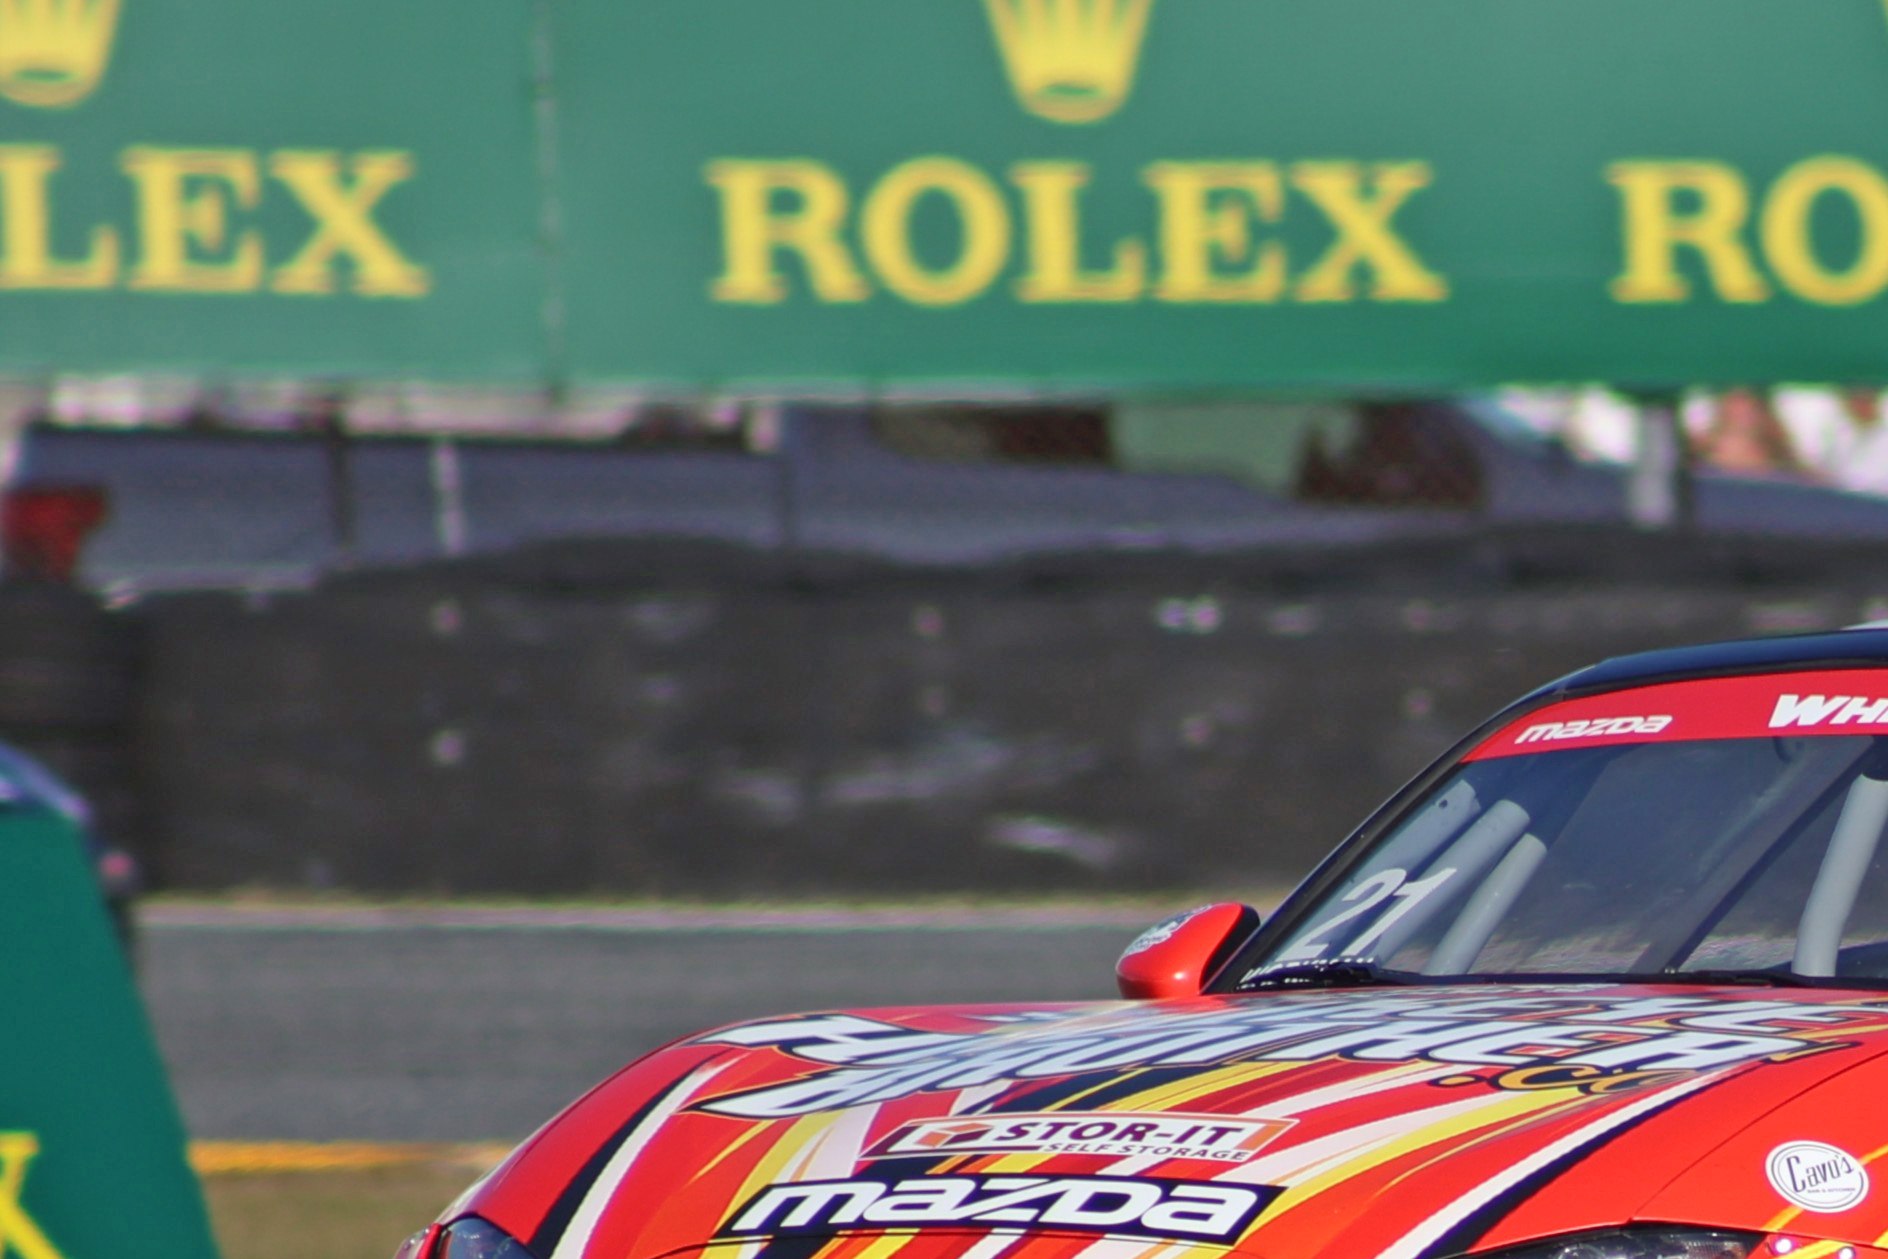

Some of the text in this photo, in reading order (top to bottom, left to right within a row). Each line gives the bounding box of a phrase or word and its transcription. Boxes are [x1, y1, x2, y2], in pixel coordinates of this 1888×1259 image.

[703, 156, 1450, 306] ROLEX
[1514, 714, 1673, 744] mazda
[1275, 868, 1457, 963] 21
[994, 1121, 1245, 1147] STOR-IT
[1044, 1142, 1250, 1162] SELF STORAGE
[731, 1178, 1258, 1235] mazda
